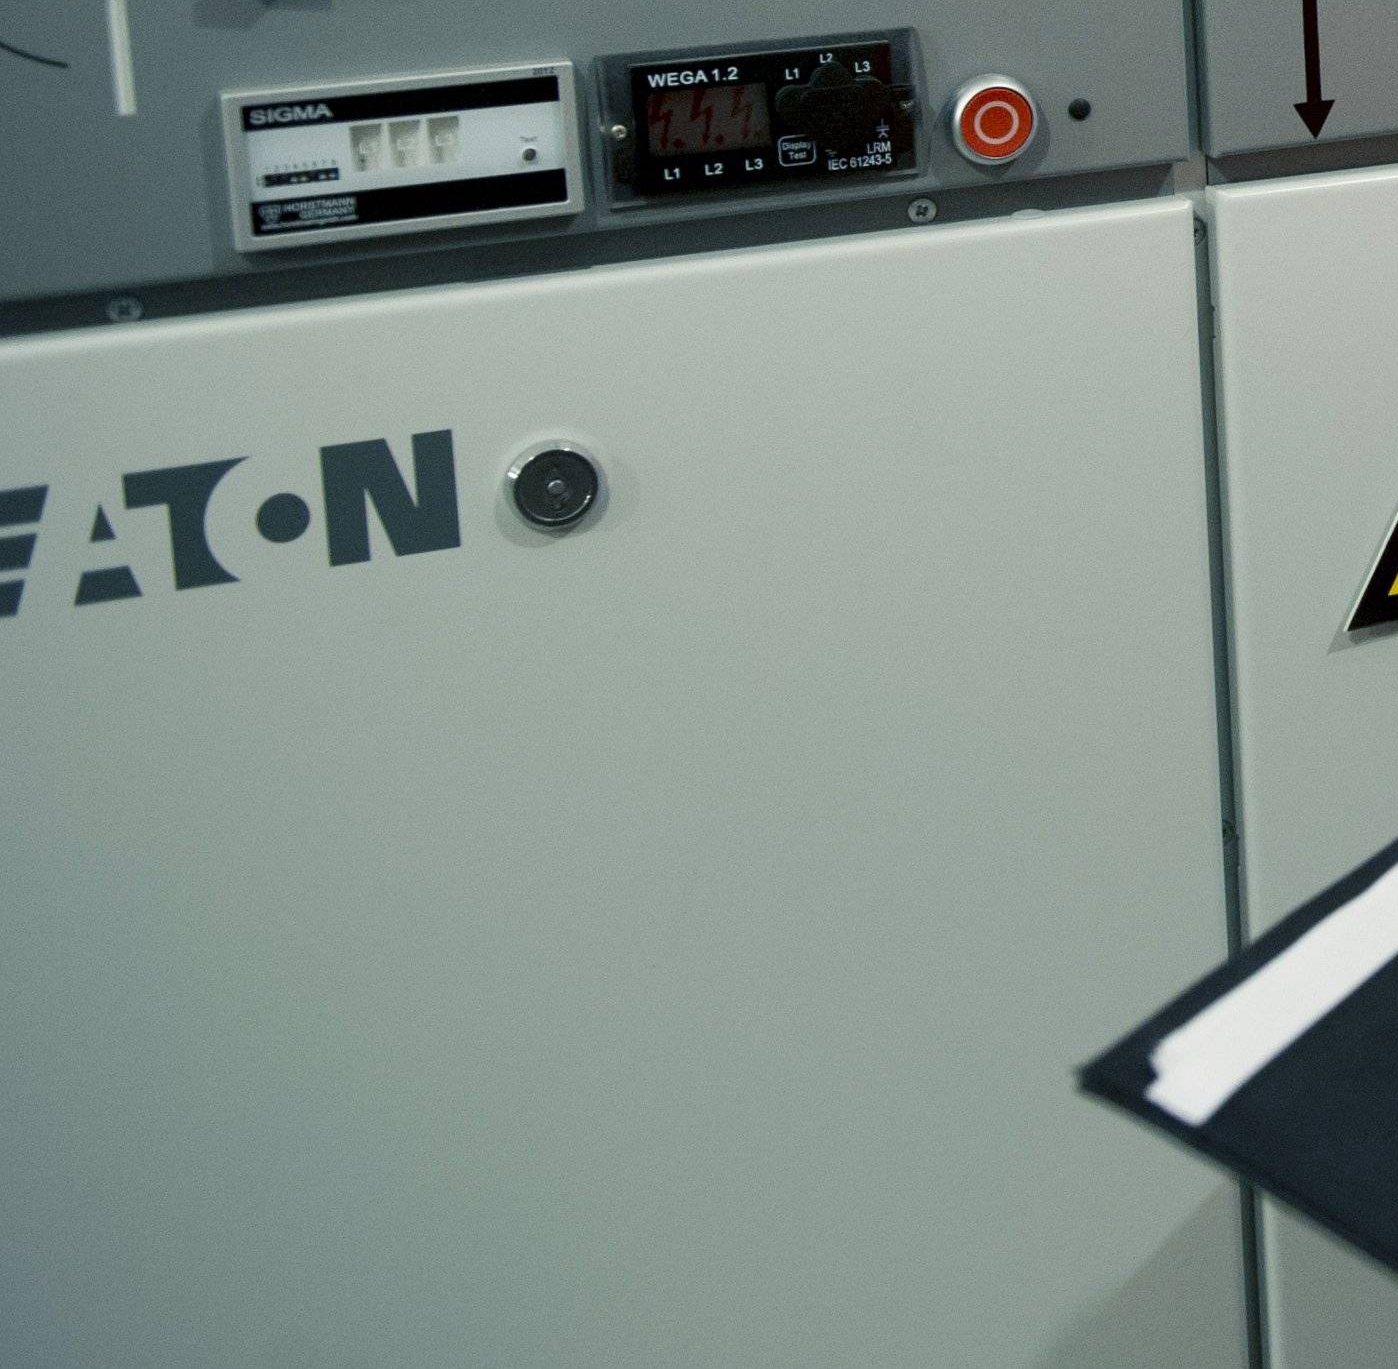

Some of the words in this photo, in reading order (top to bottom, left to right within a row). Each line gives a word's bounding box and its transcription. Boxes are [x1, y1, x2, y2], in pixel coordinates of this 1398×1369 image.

[819, 53, 833, 64] L2
[785, 67, 800, 80] L1
[854, 61, 871, 73] L3
[647, 69, 708, 88] WEGA
[712, 66, 739, 81] 1.2
[249, 103, 334, 126] SIGMA
[782, 140, 812, 152] Display
[866, 141, 892, 154] LRM
[788, 151, 807, 160] Test
[827, 158, 848, 171] IEC
[849, 153, 892, 168] 61243-5
[664, 168, 681, 180] L1
[704, 163, 724, 176] L2
[745, 158, 764, 171] L3
